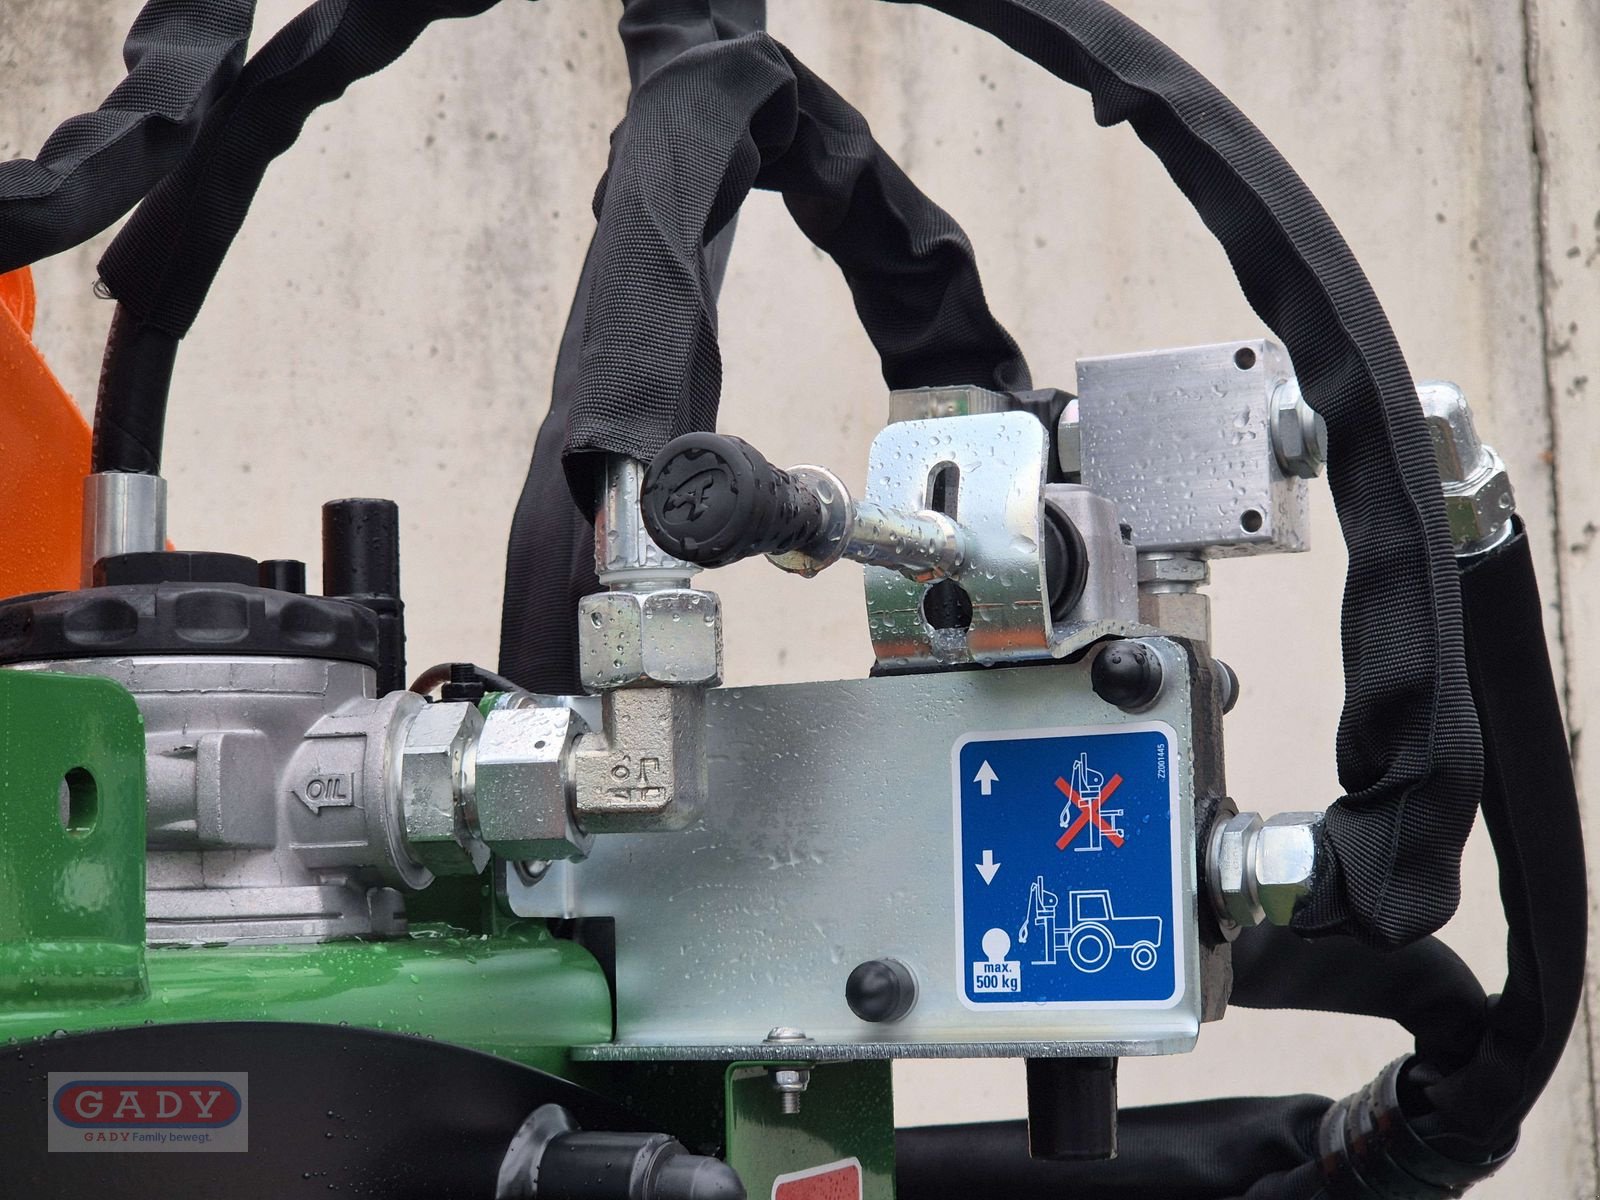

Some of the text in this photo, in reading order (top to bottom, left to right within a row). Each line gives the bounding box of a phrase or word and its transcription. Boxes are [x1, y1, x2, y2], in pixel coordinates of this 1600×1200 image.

[1157, 743, 1166, 779] Z2001445
[306, 779, 346, 800] OIL
[984, 963, 1012, 973] max.
[976, 974, 1018, 991] 500 kg
